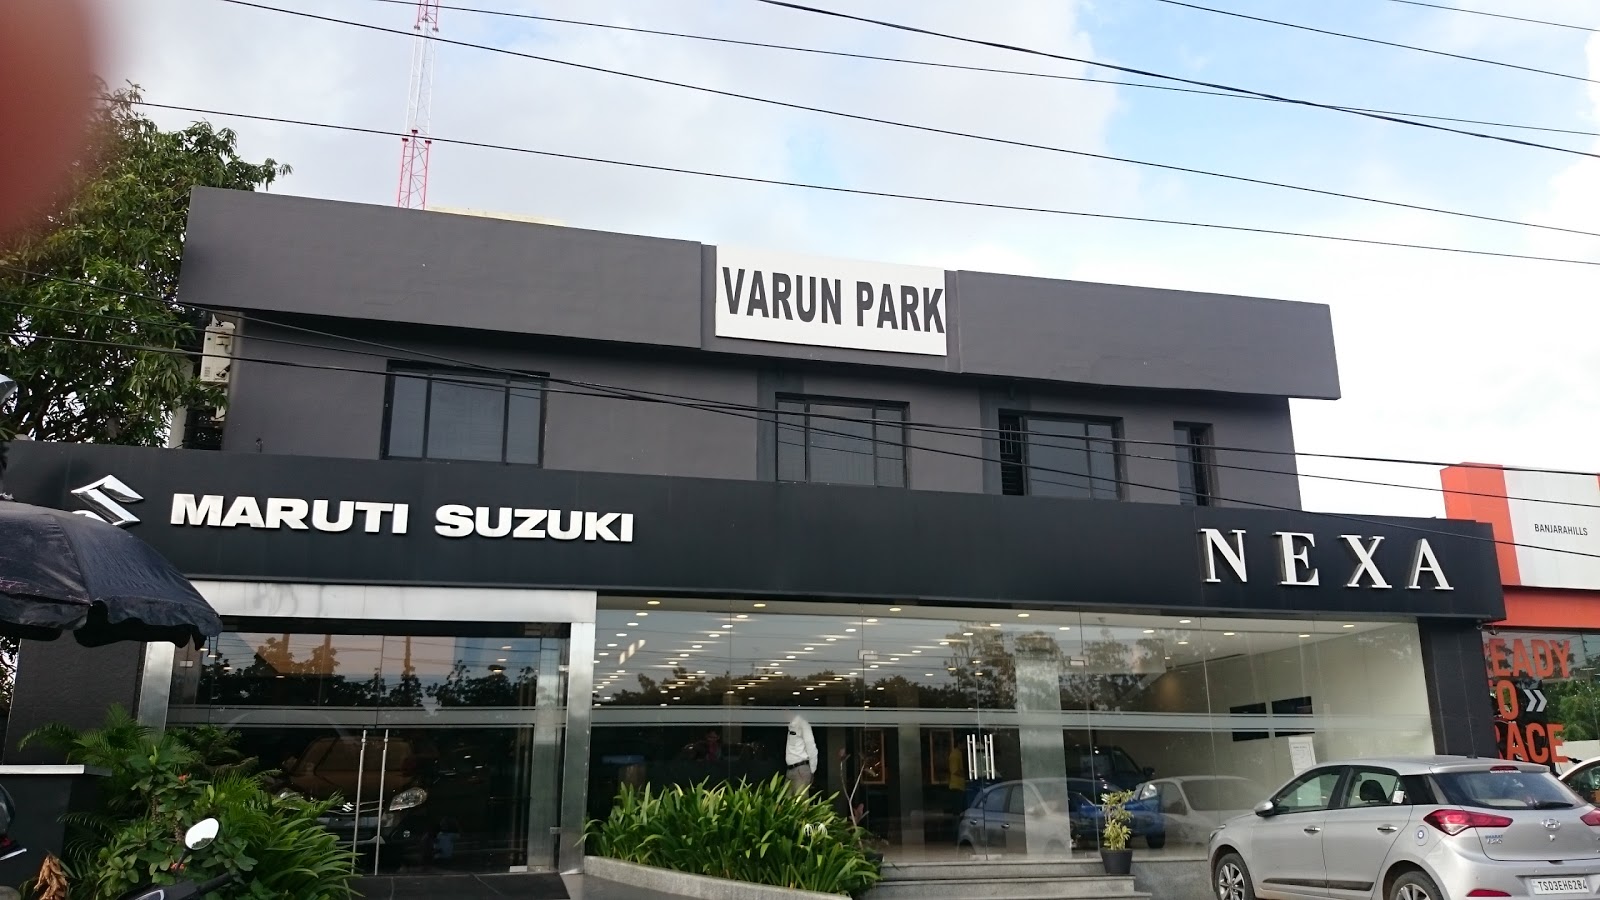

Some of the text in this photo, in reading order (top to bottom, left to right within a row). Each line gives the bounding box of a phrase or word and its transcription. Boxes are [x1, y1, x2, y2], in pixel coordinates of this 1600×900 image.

[722, 266, 945, 333] VARUN PARK
[170, 493, 634, 543] MARUTI SUZUKI
[1534, 523, 1588, 536] BANJARAHILLS
[1198, 528, 1454, 591] NEXA
[1489, 680, 1519, 720] O
